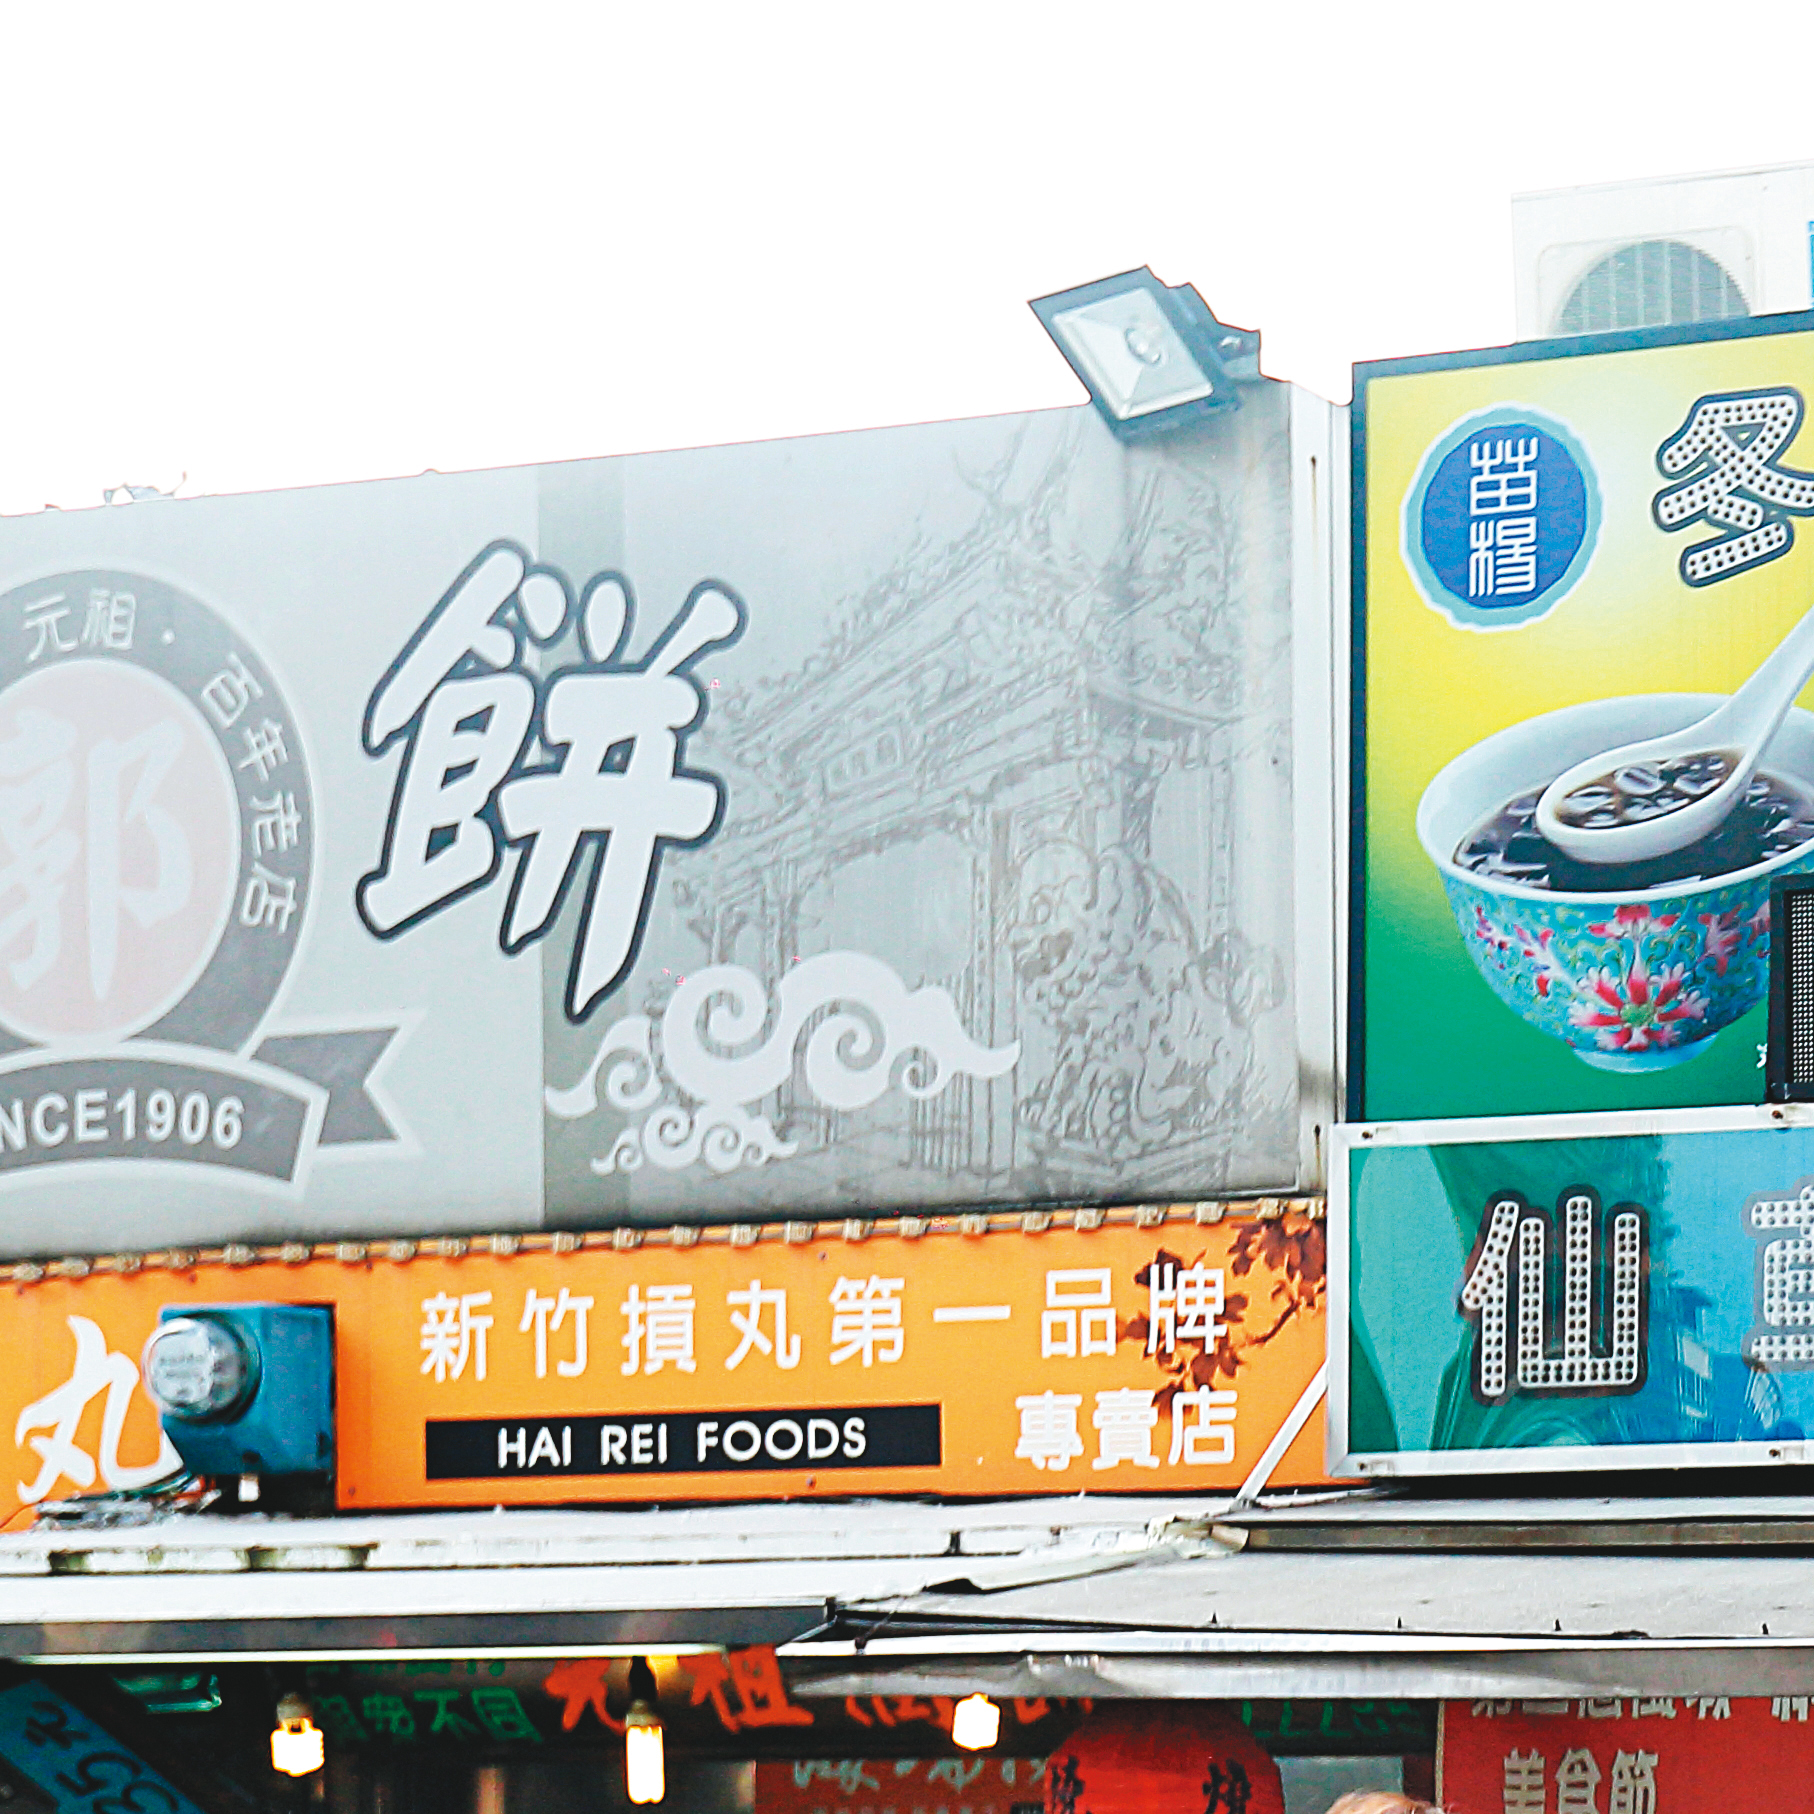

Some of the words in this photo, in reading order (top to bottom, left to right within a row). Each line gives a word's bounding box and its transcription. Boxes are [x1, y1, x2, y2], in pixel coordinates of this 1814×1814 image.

[22, 585, 138, 665] 元祖
[356, 538, 748, 1024] 餅
[420, 1264, 1228, 1382] 新竹摃丸第一品牌
[496, 1426, 574, 1468] HAI
[600, 1424, 670, 1464] REI
[696, 1418, 868, 1462] FOODS
[1014, 1390, 1238, 1474] 專賣店
